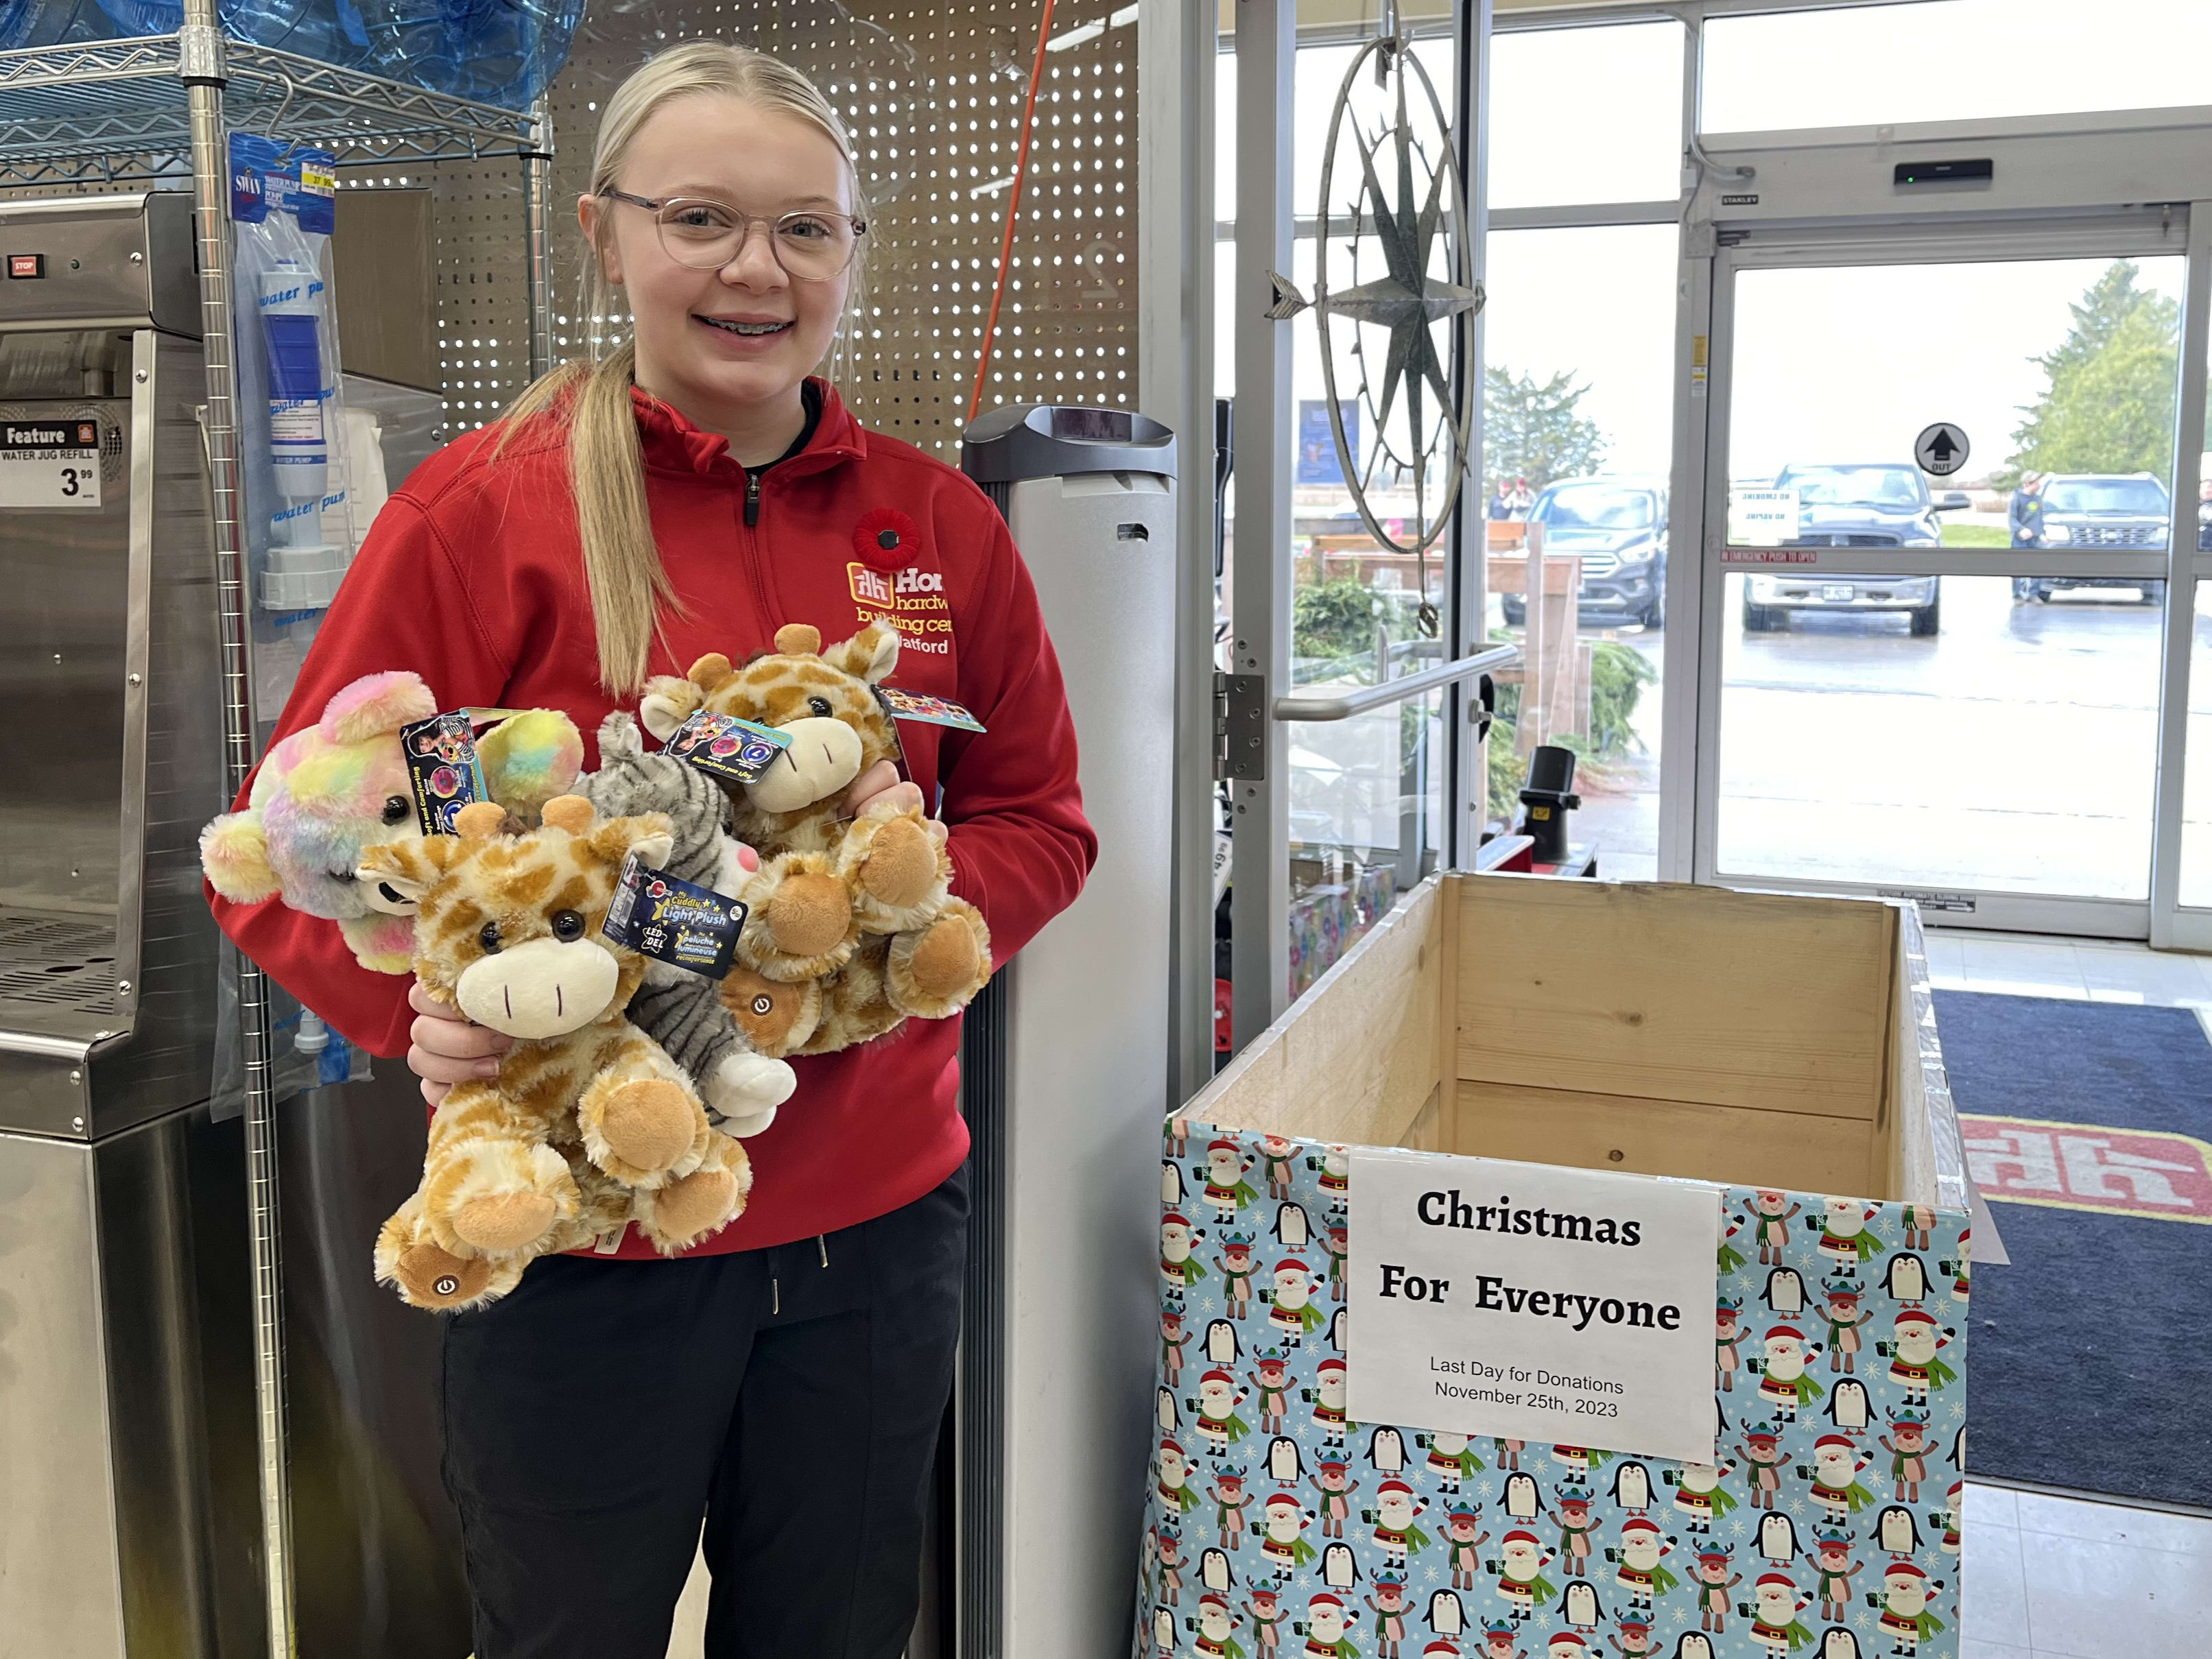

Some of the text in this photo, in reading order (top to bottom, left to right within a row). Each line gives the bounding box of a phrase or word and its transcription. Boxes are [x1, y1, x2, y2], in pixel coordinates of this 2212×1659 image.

[236, 175, 261, 194] SWAN
[259, 287, 300, 307] water
[7, 427, 65, 444] Feature
[1, 449, 93, 460] WATER JUG REFILL
[1931, 462, 1951, 472] OUT
[61, 468, 93, 496] 3 99
[899, 635, 948, 654] atford
[671, 896, 701, 909] Cuddly
[663, 905, 694, 922] Light
[695, 910, 727, 926] Plush
[646, 927, 663, 938] LED
[682, 935, 714, 946] peluche
[647, 937, 664, 948] DEL
[677, 944, 718, 957] lumineuse
[1417, 1189, 1641, 1247] Christmas
[1379, 1263, 1682, 1332] For Everyone
[1430, 1355, 1624, 1394] Last Day for Donations
[1435, 1381, 1619, 1418] November 25th, 2023
